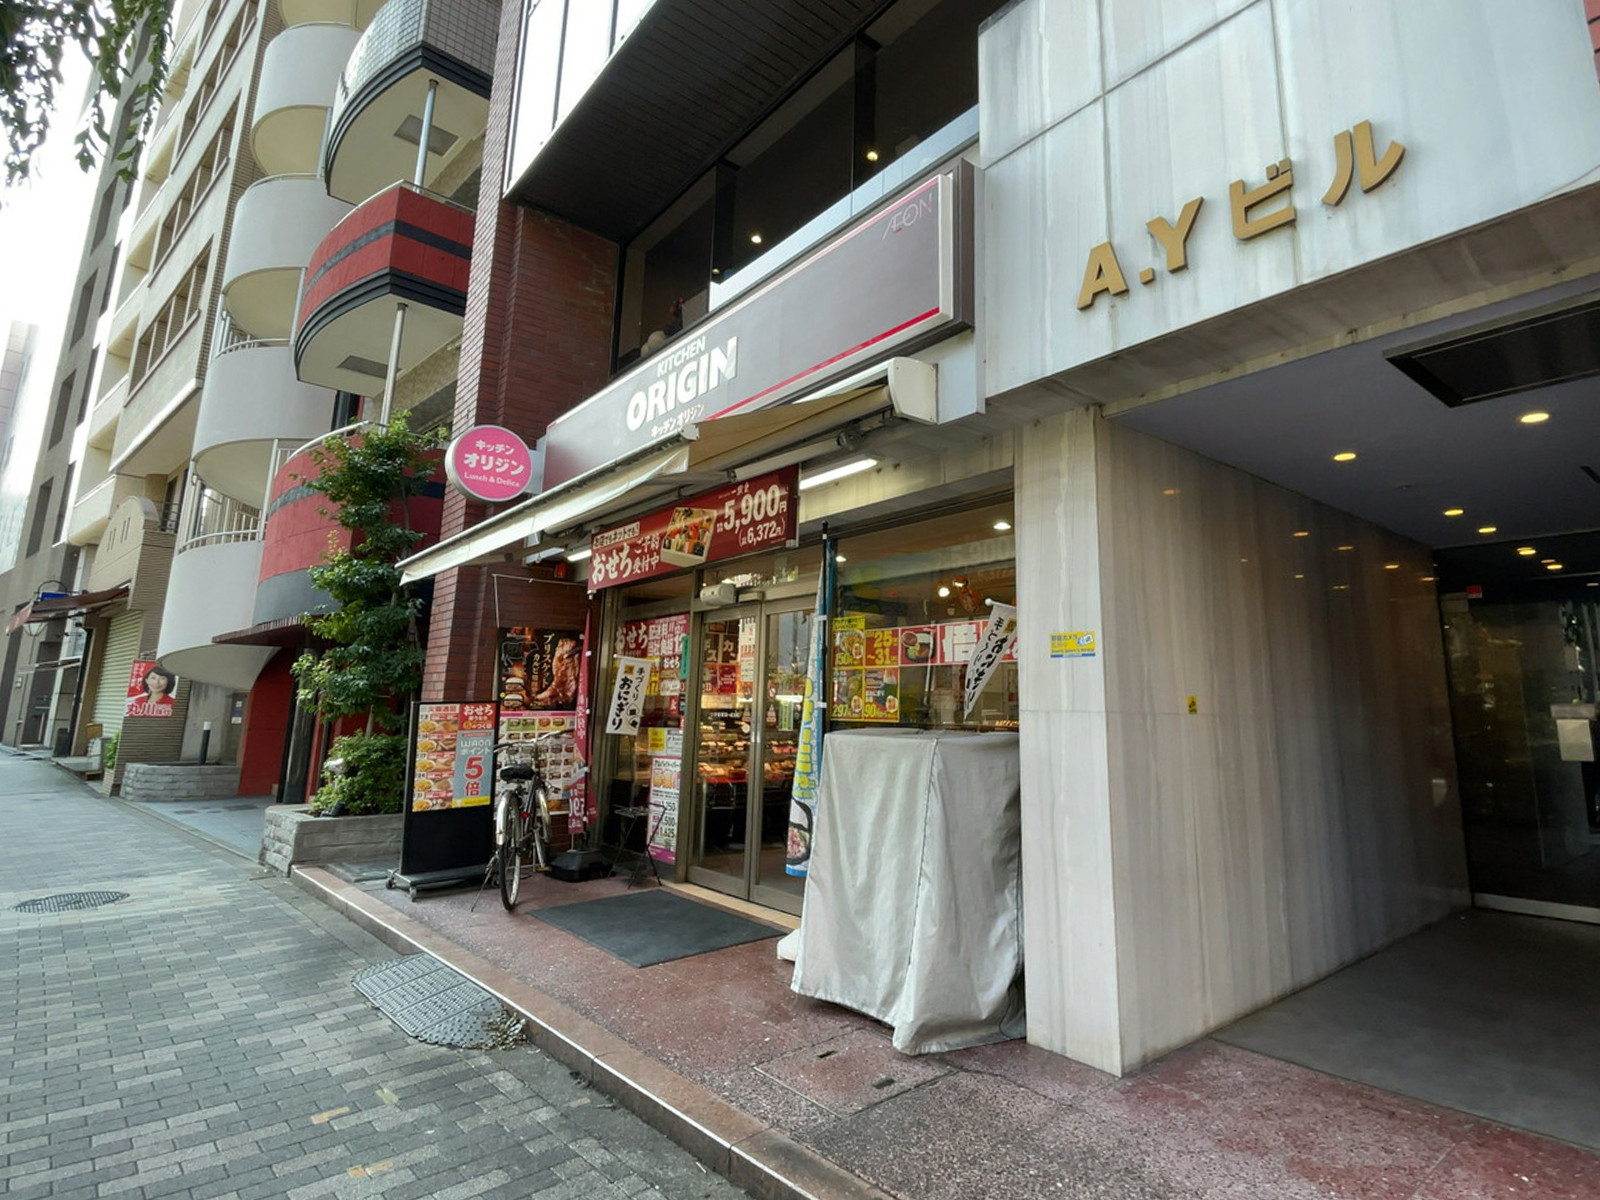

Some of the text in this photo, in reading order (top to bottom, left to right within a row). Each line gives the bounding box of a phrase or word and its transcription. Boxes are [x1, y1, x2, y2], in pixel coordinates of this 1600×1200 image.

[657, 336, 706, 377] KITCHEN
[626, 336, 738, 431] ORIGIN
[475, 439, 515, 455] キッチン
[463, 452, 525, 476] オリジン
[464, 471, 488, 482] Lunch
[592, 543, 632, 584] おせち
[633, 552, 660, 575] 受付中
[615, 622, 649, 652] おせち
[632, 667, 647, 702] 手づくり
[464, 704, 493, 716] おせち
[612, 676, 634, 732] おにぎり
[461, 747, 491, 756] ポイント
[465, 756, 484, 780] 5
[465, 780, 481, 799] 倍
